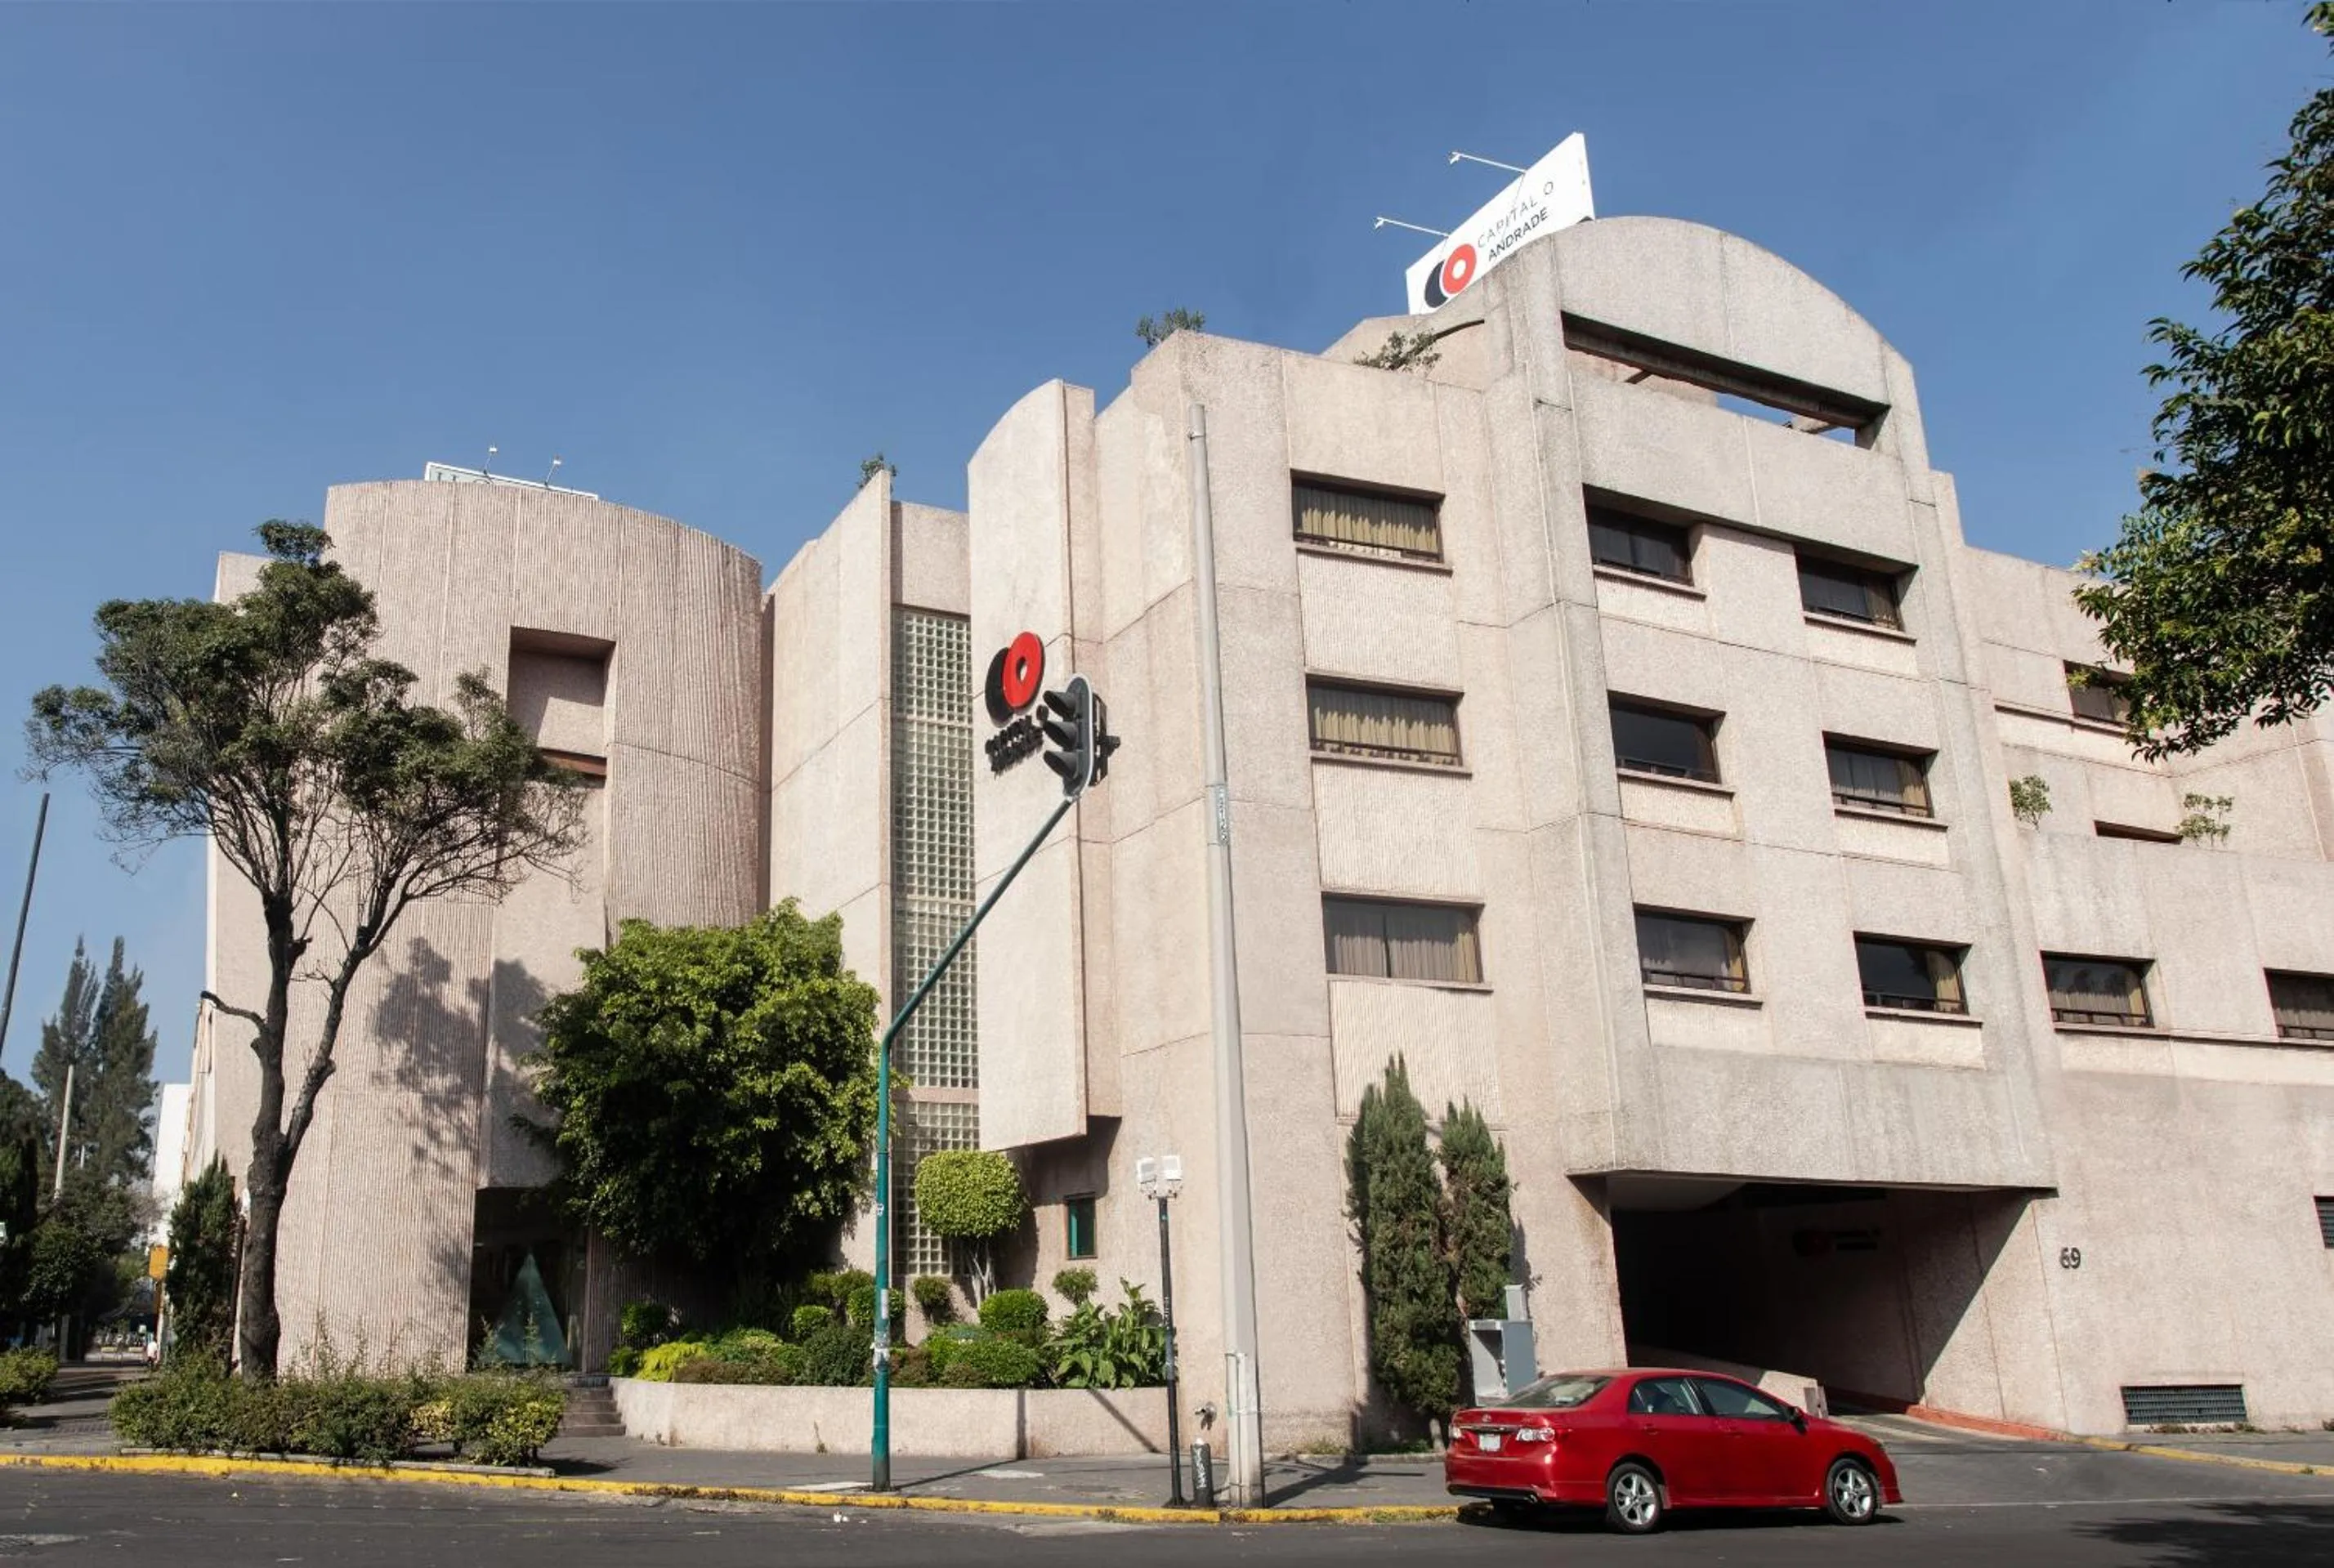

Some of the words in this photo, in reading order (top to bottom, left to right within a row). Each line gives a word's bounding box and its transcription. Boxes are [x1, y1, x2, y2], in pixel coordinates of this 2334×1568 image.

[1477, 195, 1538, 248] CAPITAL
[1542, 181, 1554, 196] O
[1488, 206, 1549, 261] ANDRADE
[2059, 1247, 2081, 1270] 69
